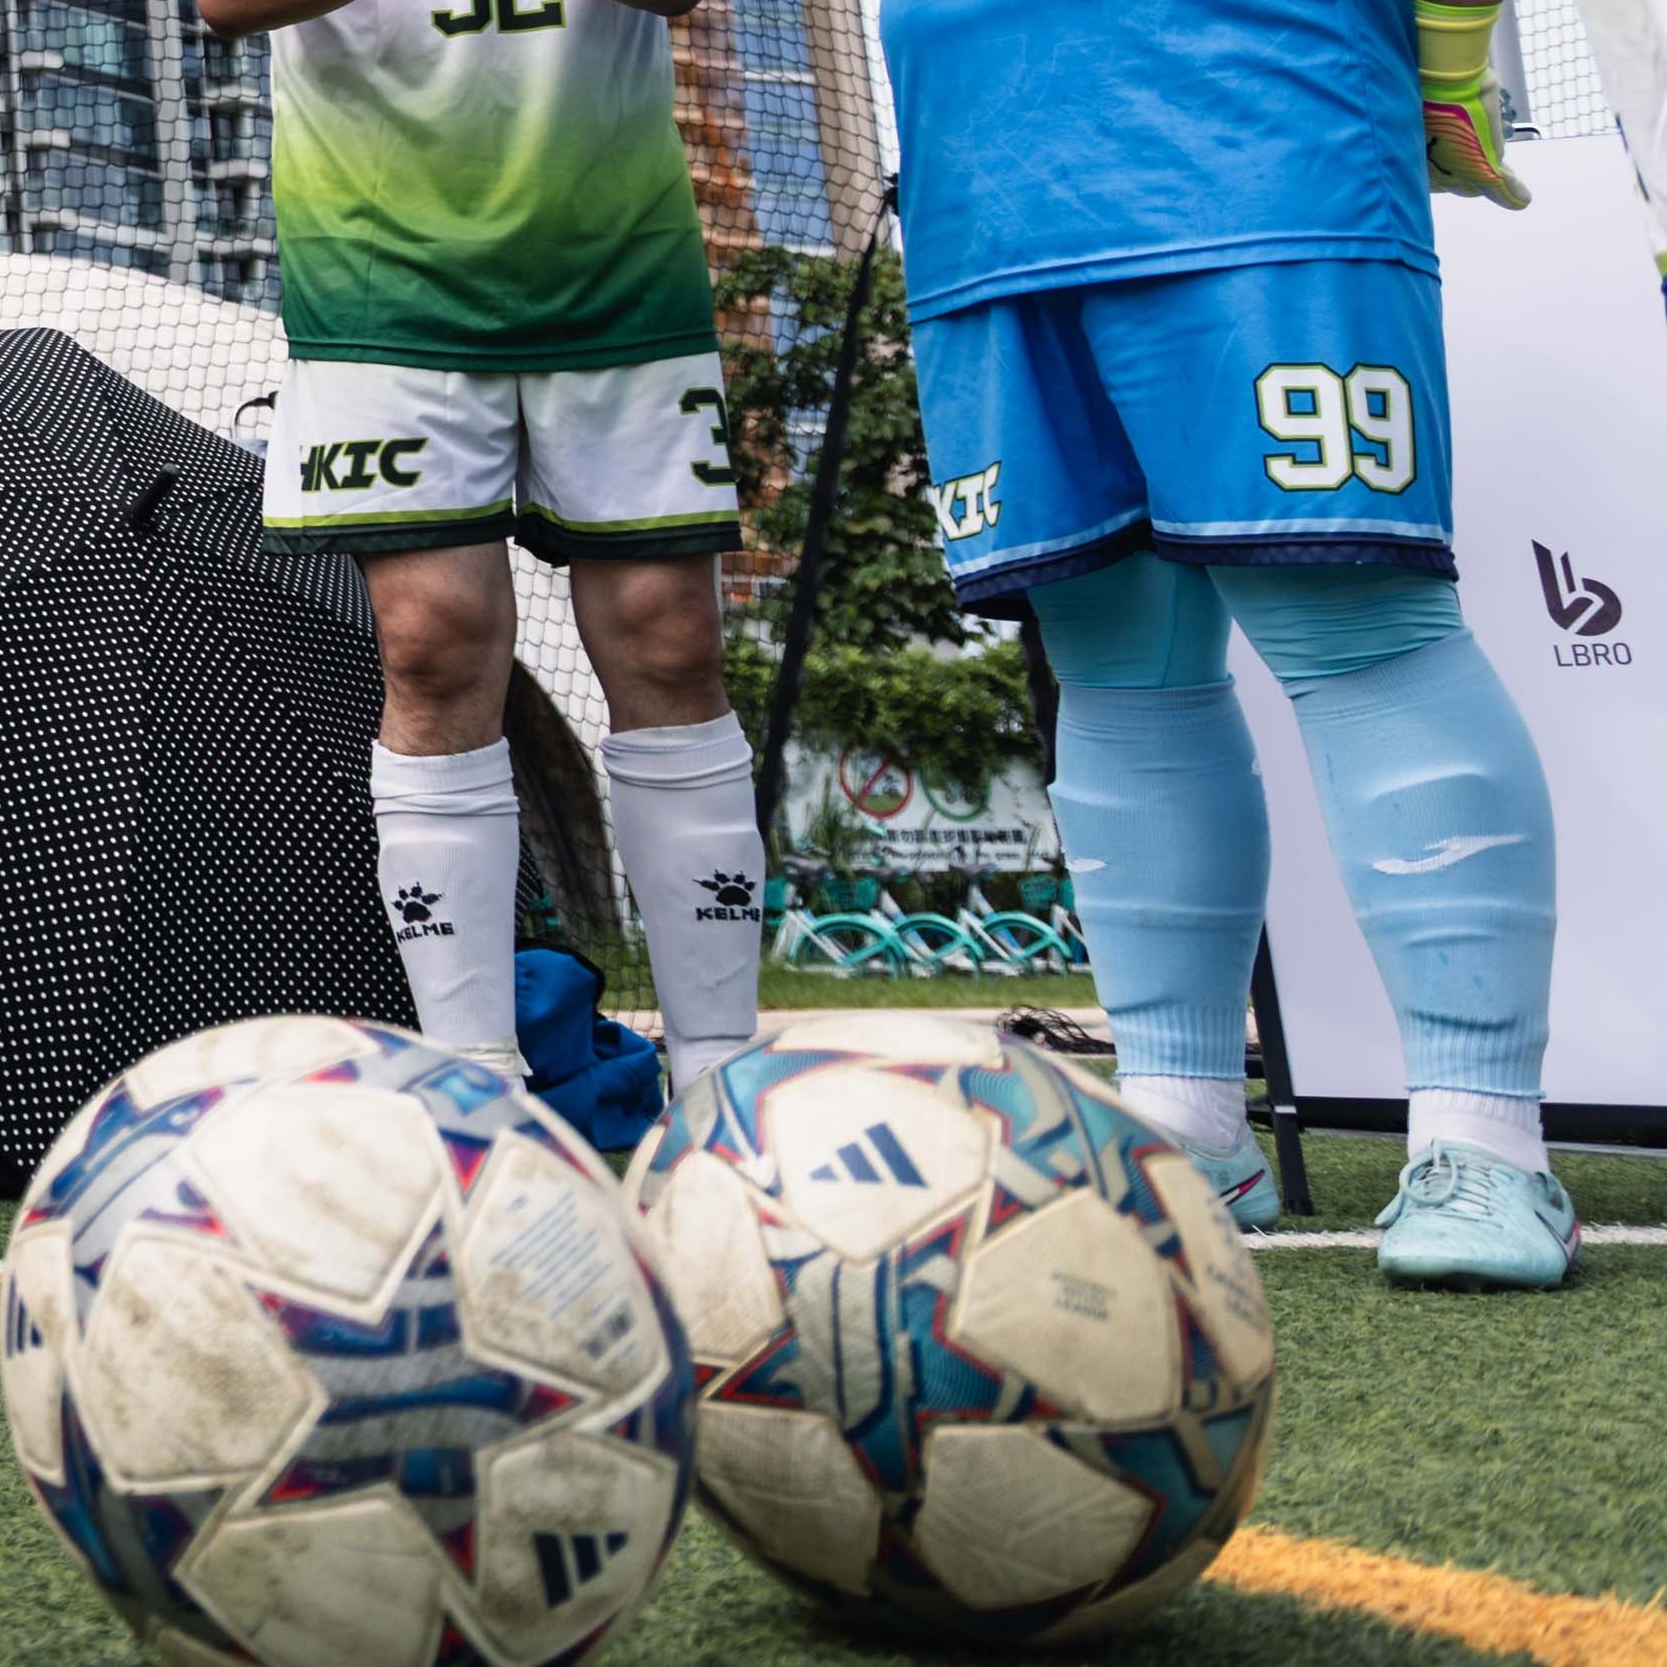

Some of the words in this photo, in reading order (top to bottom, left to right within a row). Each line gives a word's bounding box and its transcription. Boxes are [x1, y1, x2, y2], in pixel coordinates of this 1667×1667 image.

[1253, 362, 1417, 495] 99
[1553, 641, 1633, 668] LBRO
[396, 922, 455, 943] KELME
